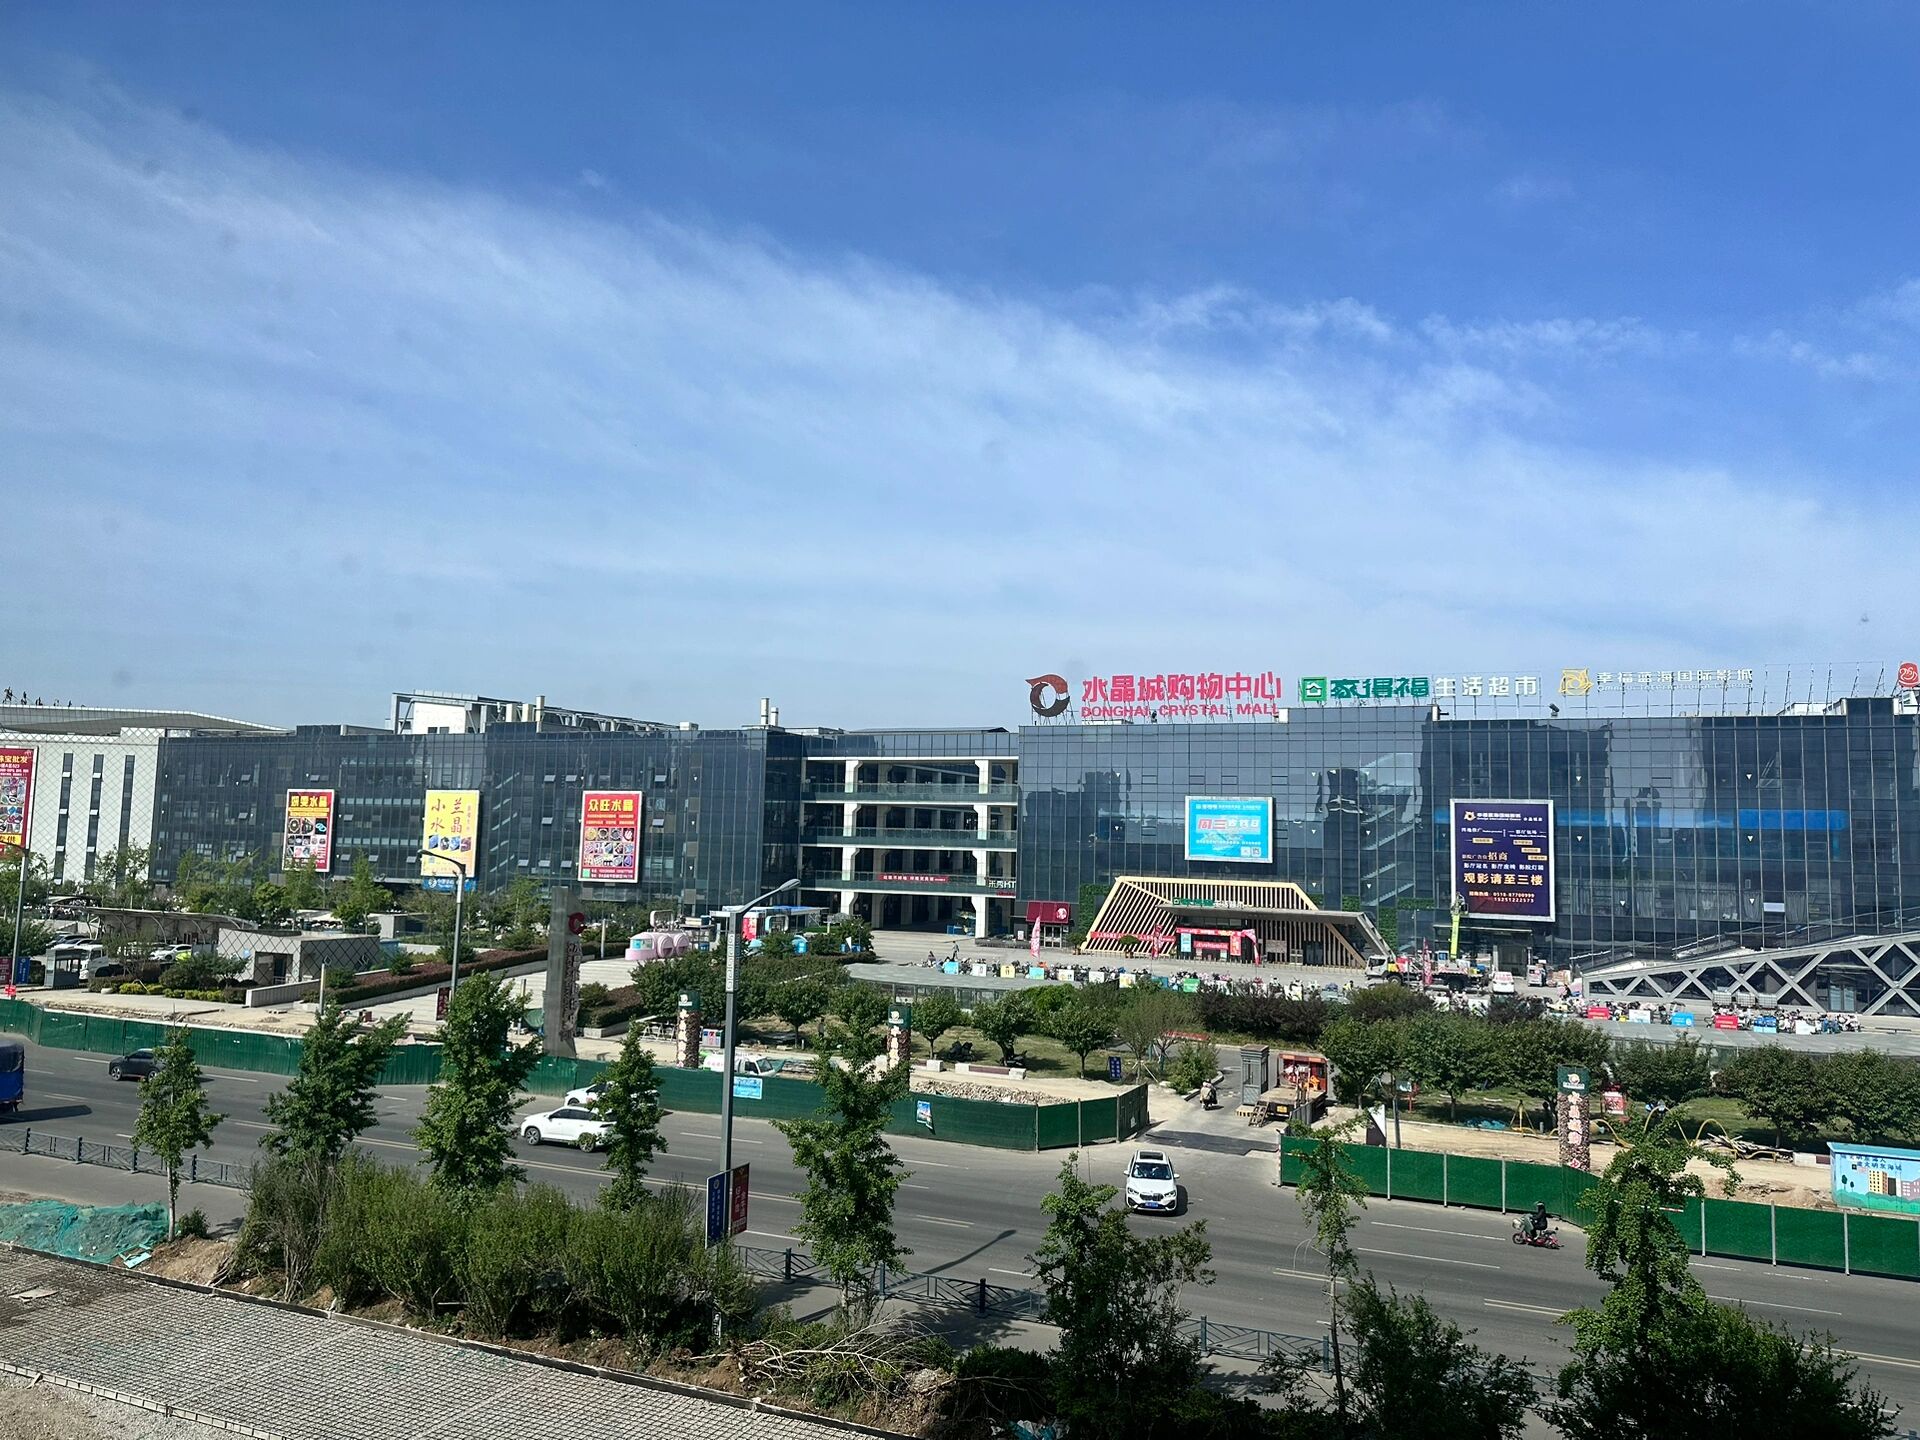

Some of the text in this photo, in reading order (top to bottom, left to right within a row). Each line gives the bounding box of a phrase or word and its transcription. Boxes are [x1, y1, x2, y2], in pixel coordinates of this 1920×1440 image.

[1597, 669, 1753, 684] 幸福蓝海国际影城
[1081, 671, 1282, 702] 水晶城购物中心
[1081, 702, 1281, 718] DONGHAI CRYSTAL MALL
[588, 799, 634, 812] 众旺水晶
[1463, 872, 1543, 886] 观影请至三楼
